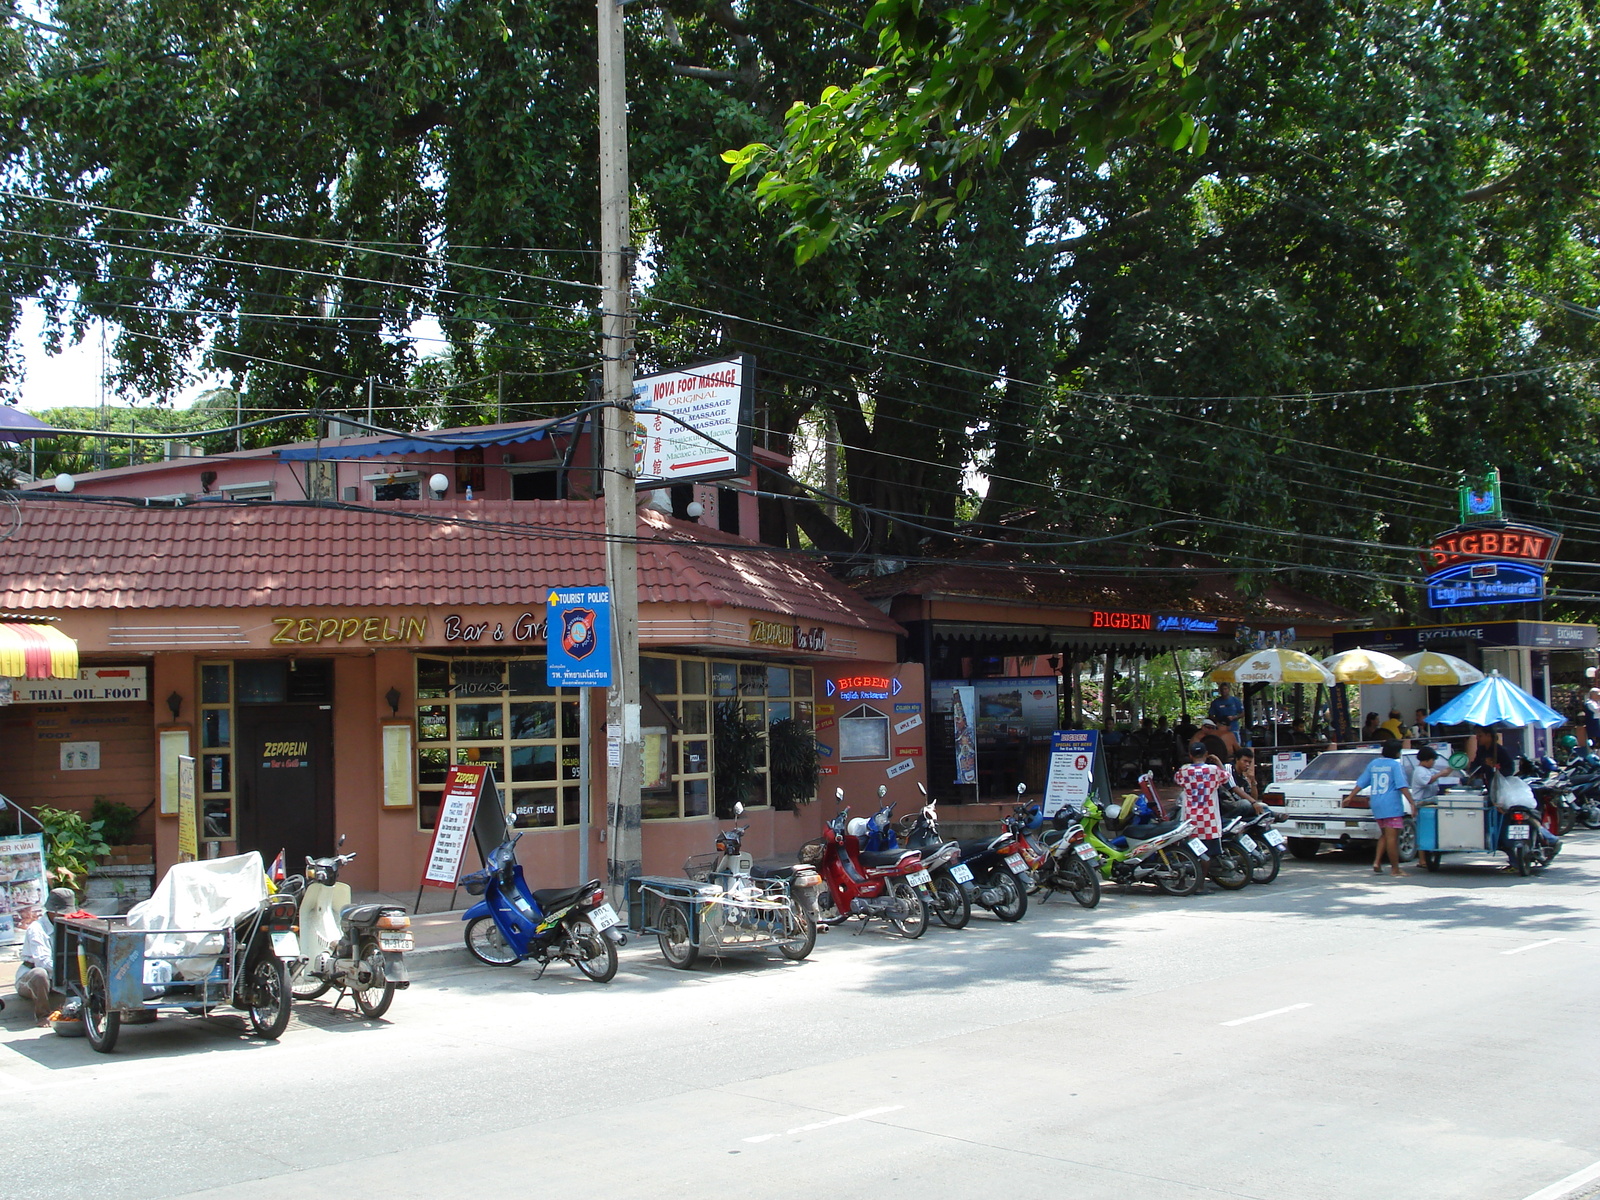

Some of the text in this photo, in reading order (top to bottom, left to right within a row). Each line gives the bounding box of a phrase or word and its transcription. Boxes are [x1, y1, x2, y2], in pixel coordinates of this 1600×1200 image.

[653, 369, 736, 402] NOVA FOOT MASSAGE
[668, 391, 718, 406] ORIGINAL
[671, 399, 732, 415] THAI MASSAGE
[688, 409, 727, 421] MASSAGE
[1430, 533, 1545, 564] BIGBEN
[1436, 578, 1537, 603] English Restaurant
[559, 592, 609, 604] TOURIST POLICE
[1092, 611, 1152, 630] BIGBEN
[270, 612, 547, 644] ZEPPELIN Bar & Gri
[1557, 630, 1584, 640] EXCHANGE
[1417, 628, 1484, 643] EXCHANGE
[838, 676, 890, 690] BIGBEN
[29, 689, 63, 700] THAI
[73, 688, 96, 699] OIL
[104, 688, 141, 699] FOOT
[840, 690, 859, 701] English
[1060, 733, 1088, 741] BIGBEN
[263, 741, 308, 757] ZEPPELIN
[455, 772, 480, 784] ZEPPELIN
[1371, 772, 1390, 796] 19
[516, 805, 555, 815] GREAT STEAK
[600, 918, 614, 928] 631
